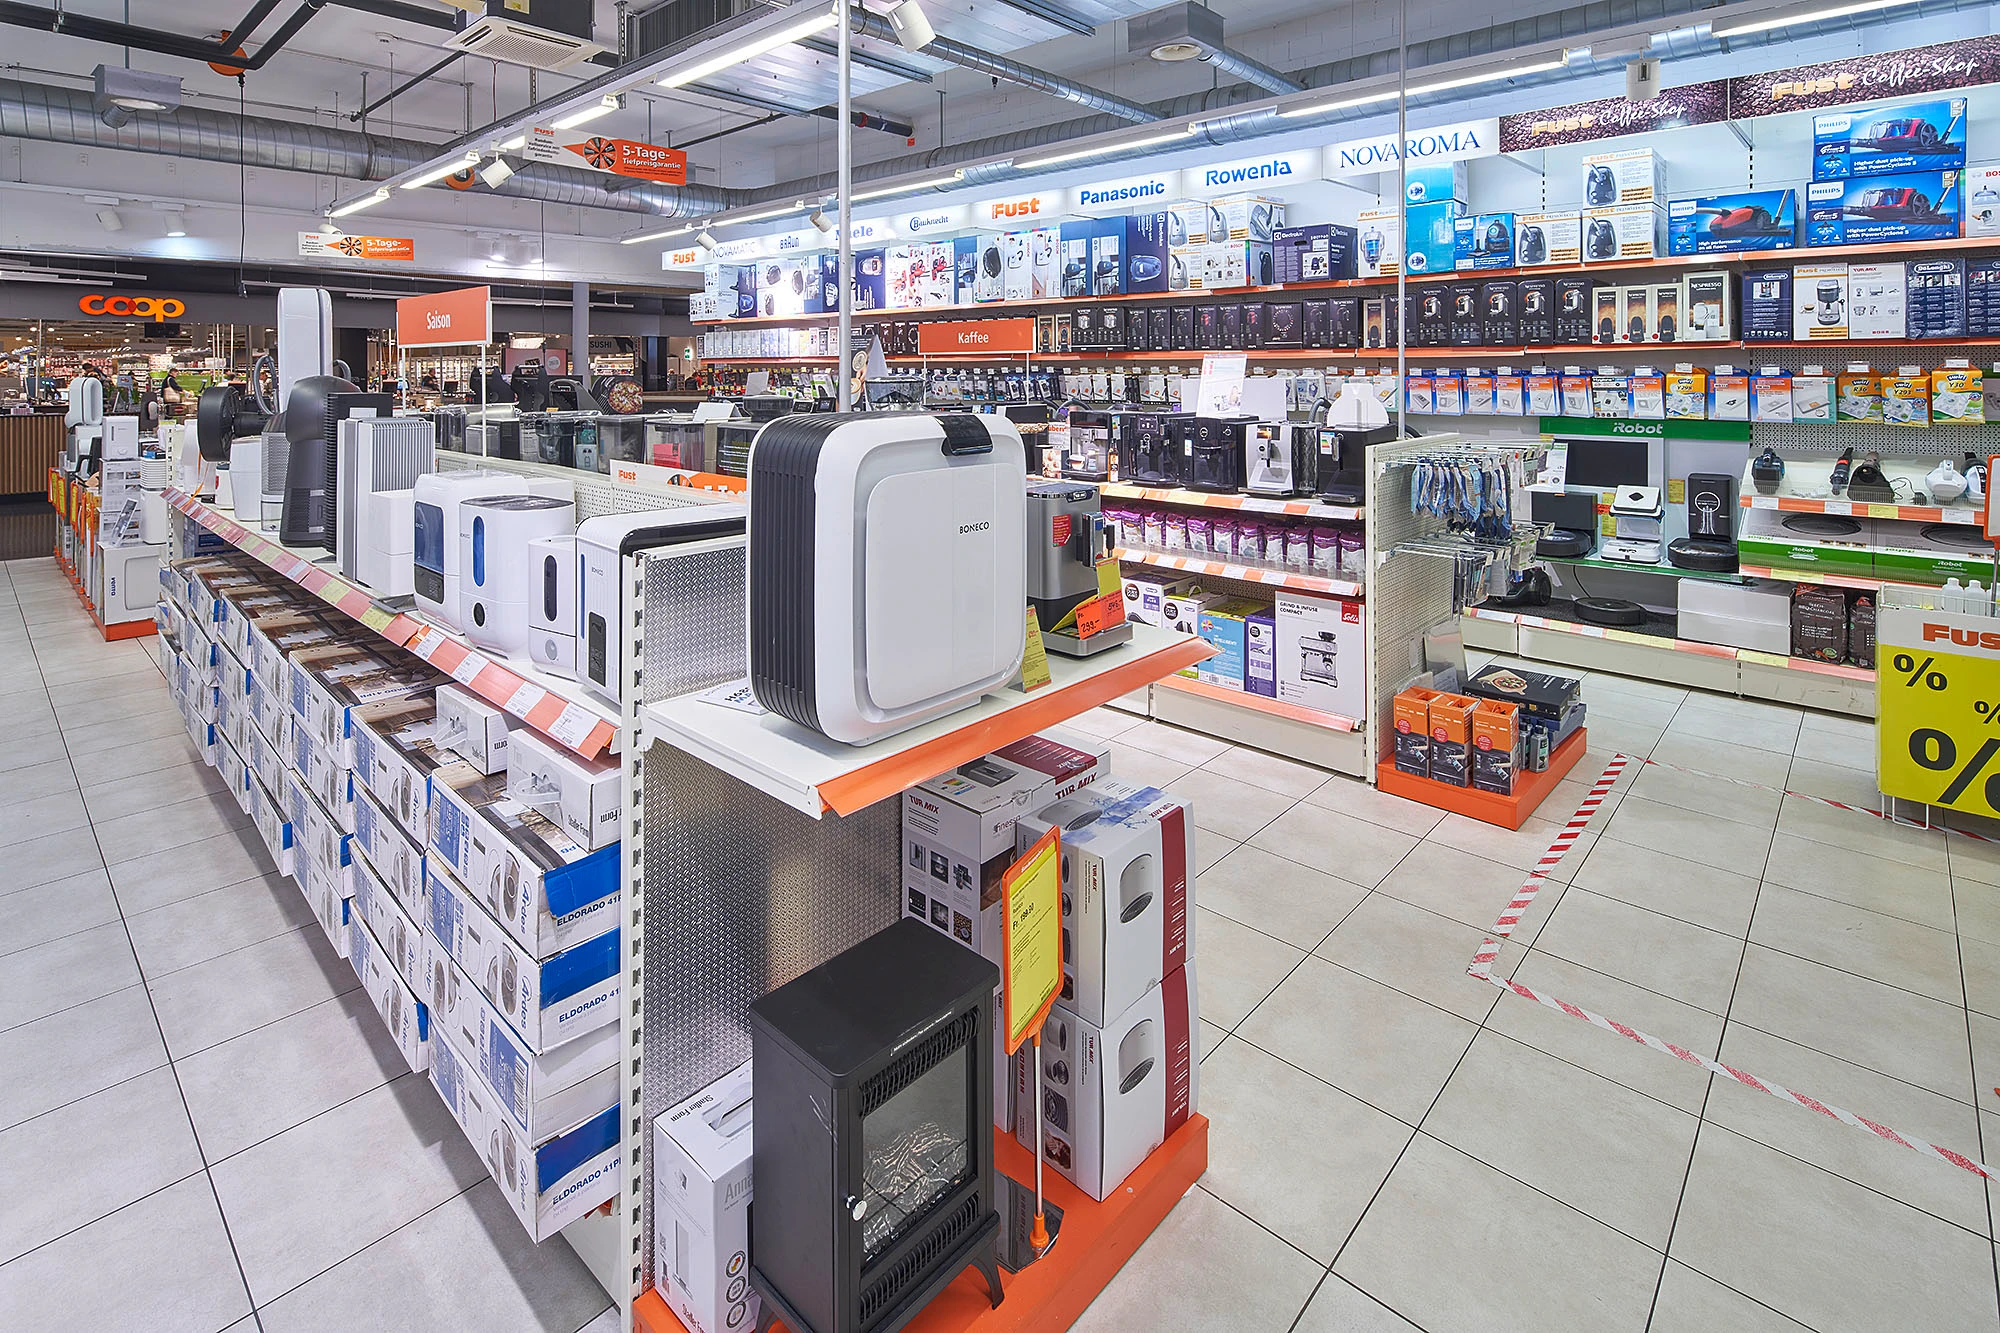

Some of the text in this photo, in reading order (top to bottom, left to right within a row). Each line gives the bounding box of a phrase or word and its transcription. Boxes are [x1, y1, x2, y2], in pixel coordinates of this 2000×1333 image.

[1862, 55, 1979, 86] Coffee-Shop
[1599, 101, 1687, 127] Coffee-Shop
[1818, 120, 1848, 128] PHILIPS
[622, 145, 671, 161] 5-Tage-
[1340, 130, 1480, 169] NOVAROMA
[623, 157, 682, 170] Tiefpreisgarantie
[1206, 160, 1292, 187] Rowenta
[1080, 180, 1165, 205] Panasonic
[1811, 187, 1841, 195] PHILIPS
[992, 197, 1040, 219] Fust
[909, 216, 949, 232] Bauknecht
[367, 240, 402, 249] 5-Tage-
[672, 250, 696, 265] Fust
[79, 294, 185, 322] coop
[426, 309, 451, 330] Saison
[589, 340, 612, 349] SUSHI
[958, 331, 989, 344] Kaffee
[1613, 422, 1663, 434] iRobot
[618, 469, 637, 481] Fust
[959, 521, 990, 535] BONECO
[1280, 607, 1303, 615] COMPACT
[1343, 613, 1360, 623] Solis
[1893, 653, 1948, 691] %
[924, 802, 940, 815] MIX
[556, 900, 606, 928] ELDORADO
[558, 993, 608, 1024] ELDORADO
[670, 1094, 714, 1123] Stadler Form
[552, 1169, 601, 1205] ELDORADO
[725, 1172, 753, 1204] Anna
